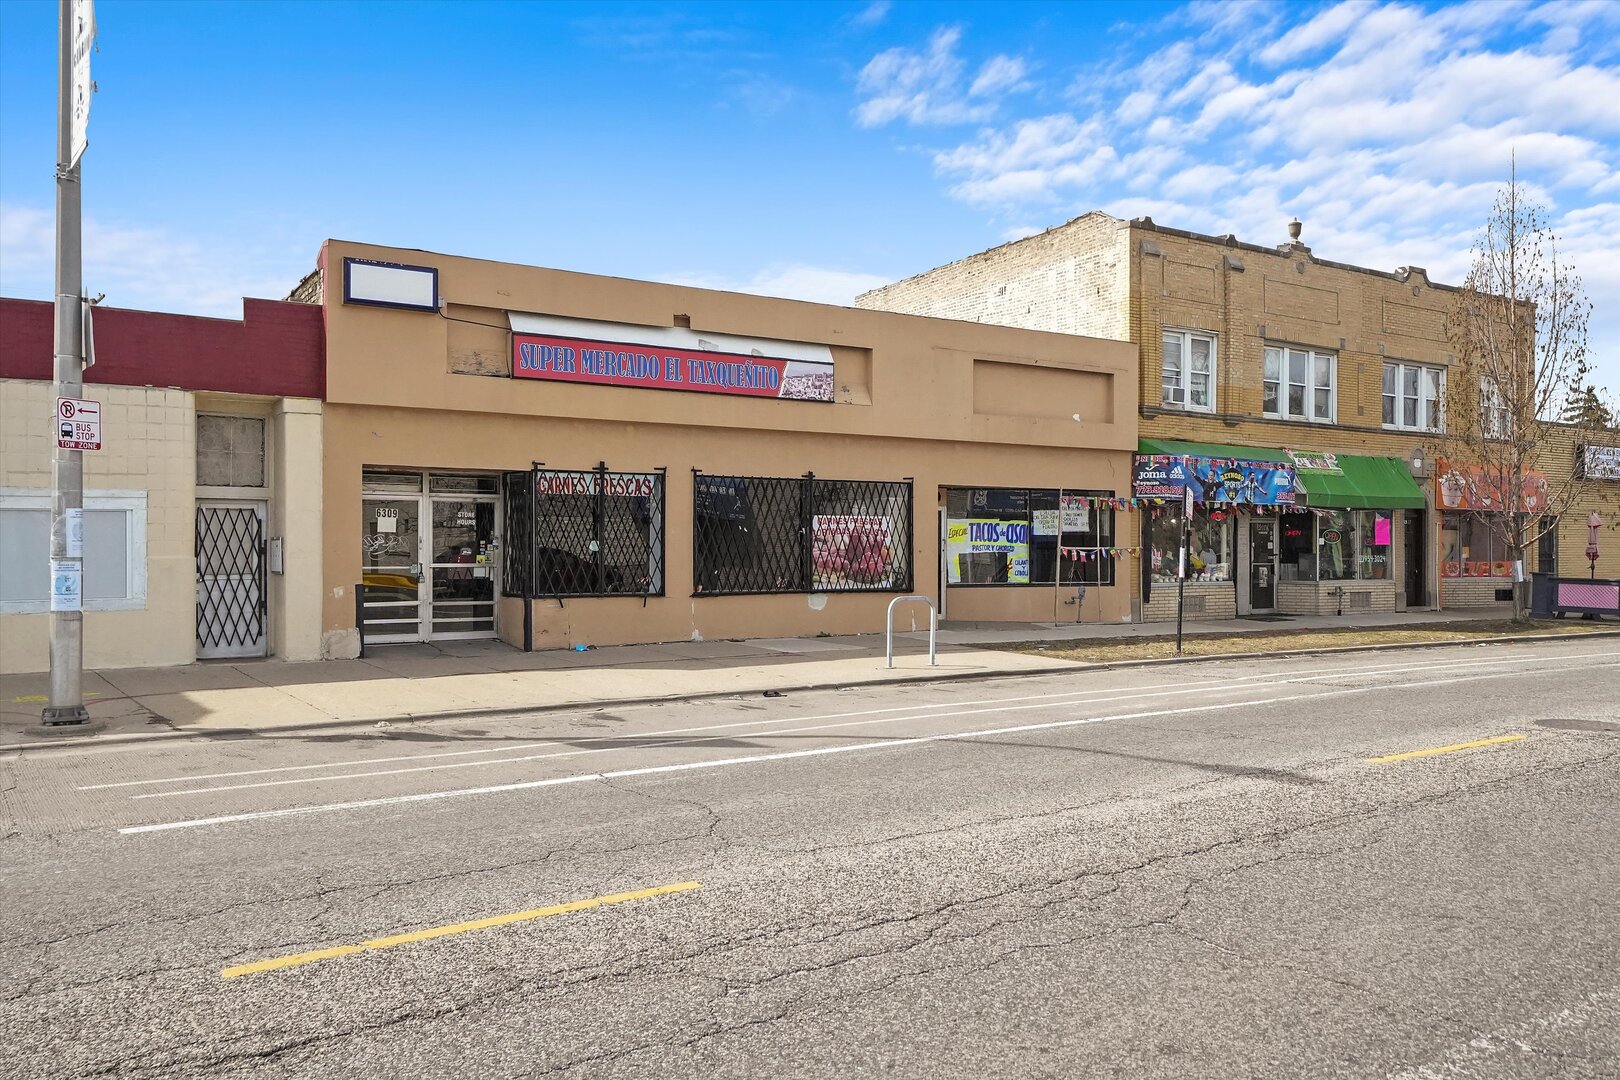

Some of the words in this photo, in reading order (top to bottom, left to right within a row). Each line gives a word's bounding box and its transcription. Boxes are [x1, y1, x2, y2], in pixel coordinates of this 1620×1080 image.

[520, 343, 575, 372] SUPER
[581, 349, 660, 378] MERCADO
[665, 357, 682, 381] EL
[688, 360, 779, 388] TAXQUEÑITO
[76, 423, 91, 432] BUS
[76, 432, 95, 440] STOP
[538, 477, 586, 495] CARNES
[593, 477, 652, 496] FRESCAS
[376, 508, 398, 518] 6309
[969, 522, 1000, 542] TACOS
